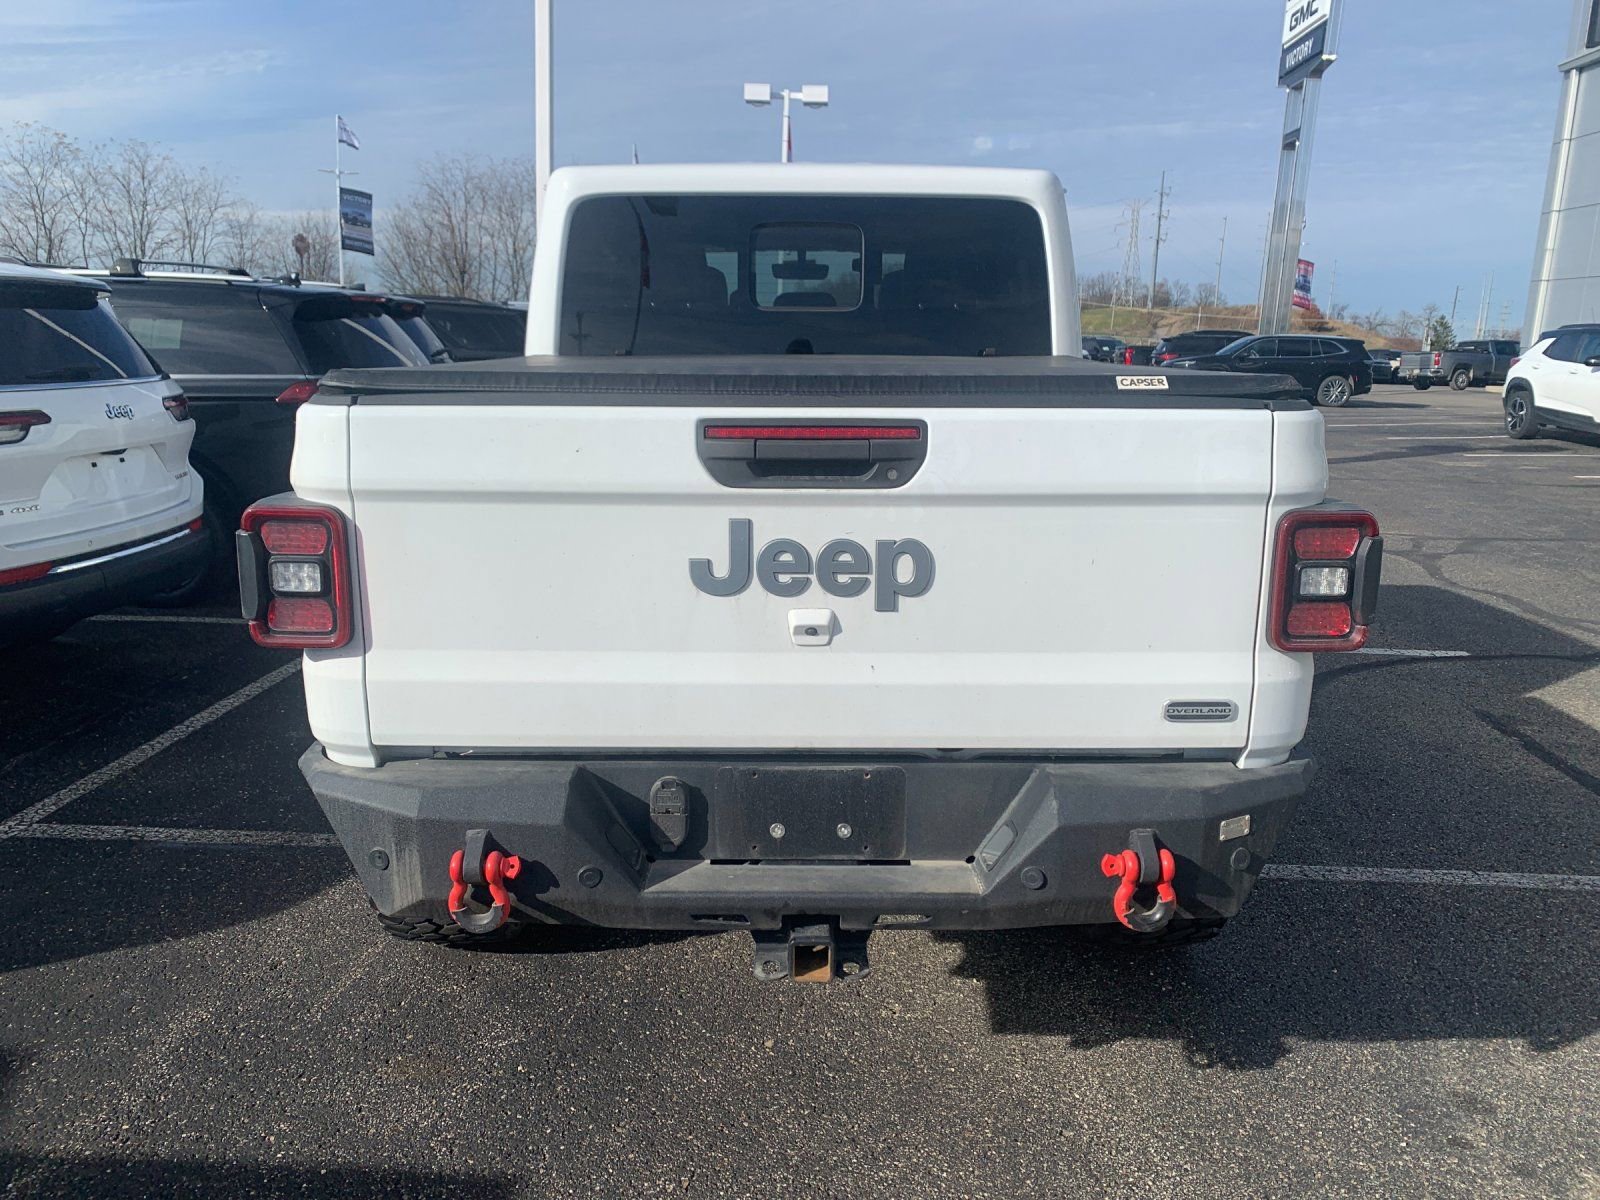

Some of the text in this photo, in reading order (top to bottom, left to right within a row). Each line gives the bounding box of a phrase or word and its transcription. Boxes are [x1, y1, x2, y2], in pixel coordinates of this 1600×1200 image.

[1289, 0, 1319, 32] GMC
[1286, 37, 1314, 69] VICTORY
[1120, 378, 1165, 387] CAPSER
[105, 403, 134, 420] Jeep
[688, 517, 935, 612] Jeep
